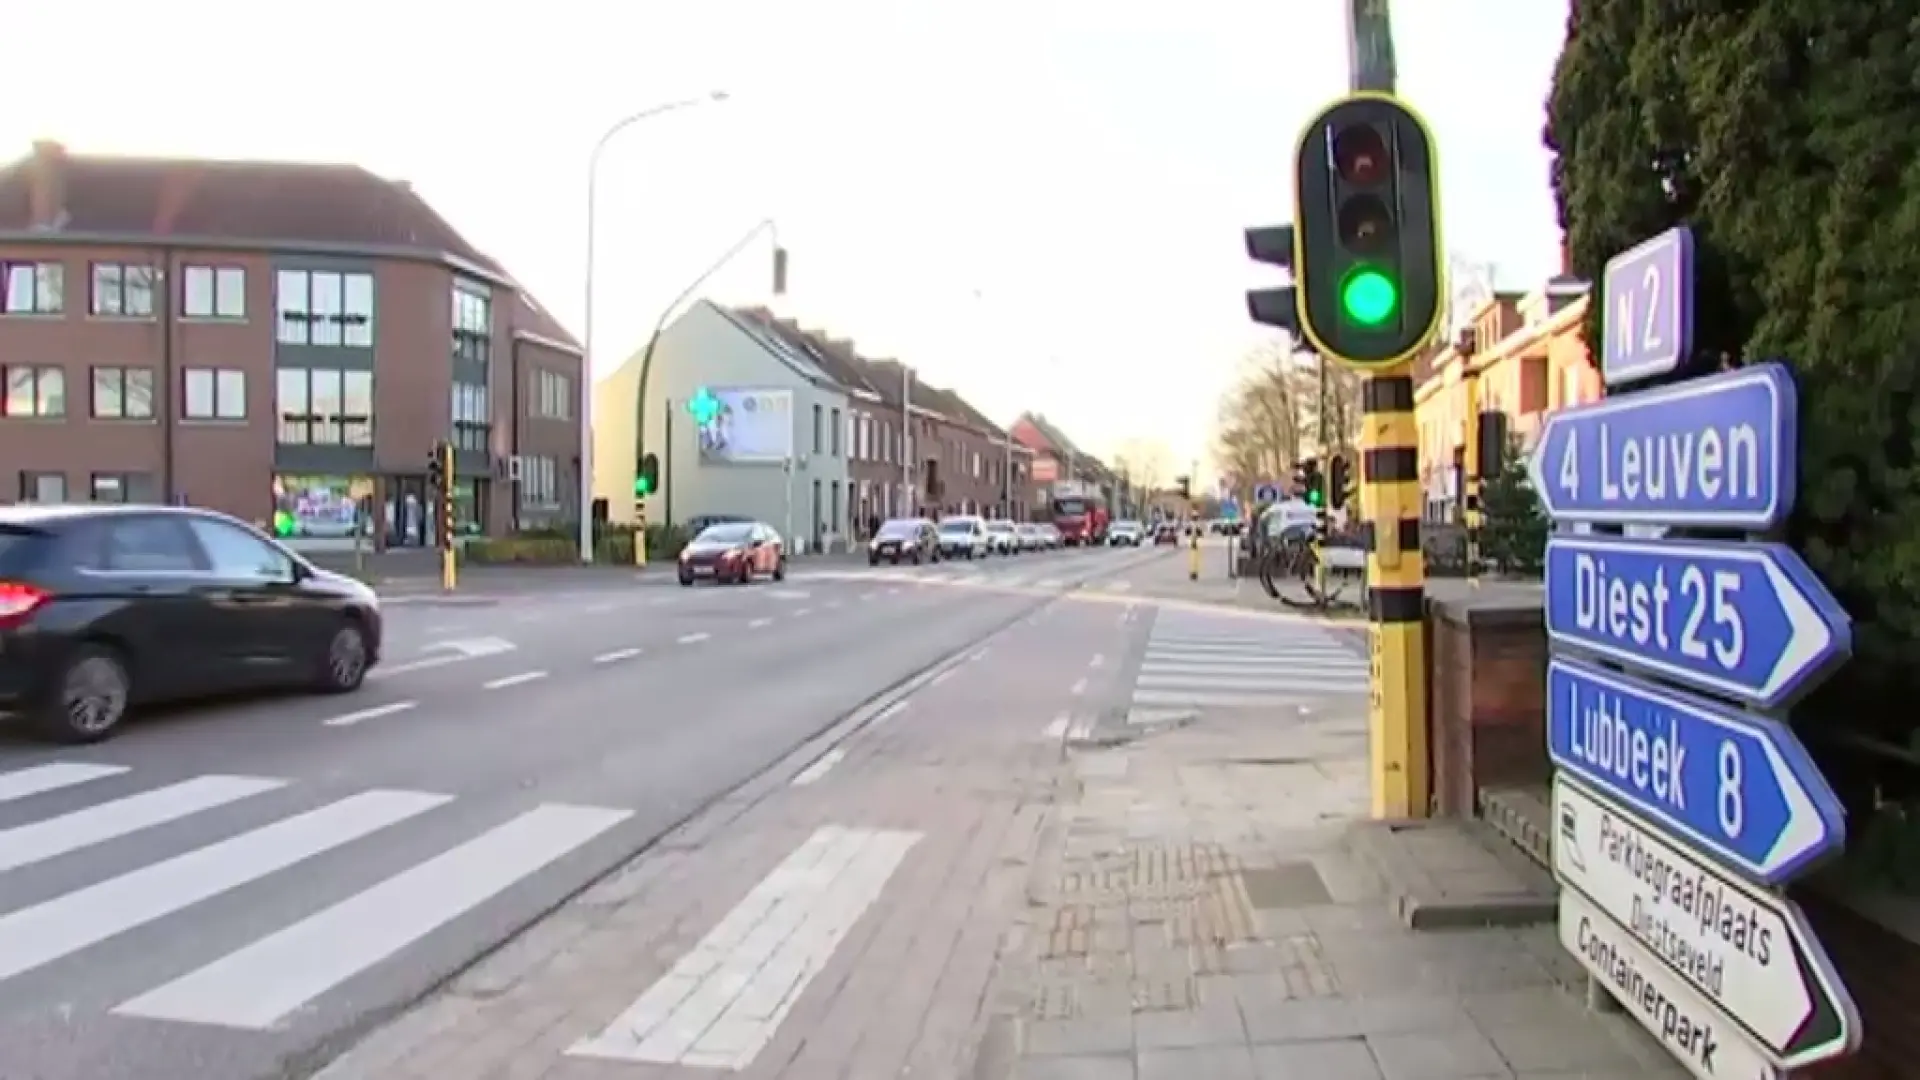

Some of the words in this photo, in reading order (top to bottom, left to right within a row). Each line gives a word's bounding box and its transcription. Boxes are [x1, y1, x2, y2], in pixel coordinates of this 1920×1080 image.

[1617, 291, 1635, 360] N
[1643, 264, 1662, 350] 2
[1559, 427, 1579, 500] 4
[1600, 421, 1757, 501] Leuven
[1575, 553, 1669, 650] Diest
[1680, 564, 1744, 670] 25
[1718, 738, 1743, 839] 8
[1600, 815, 1771, 966] Parkbegraafplaats
[1577, 916, 1719, 1073] Containerpark
